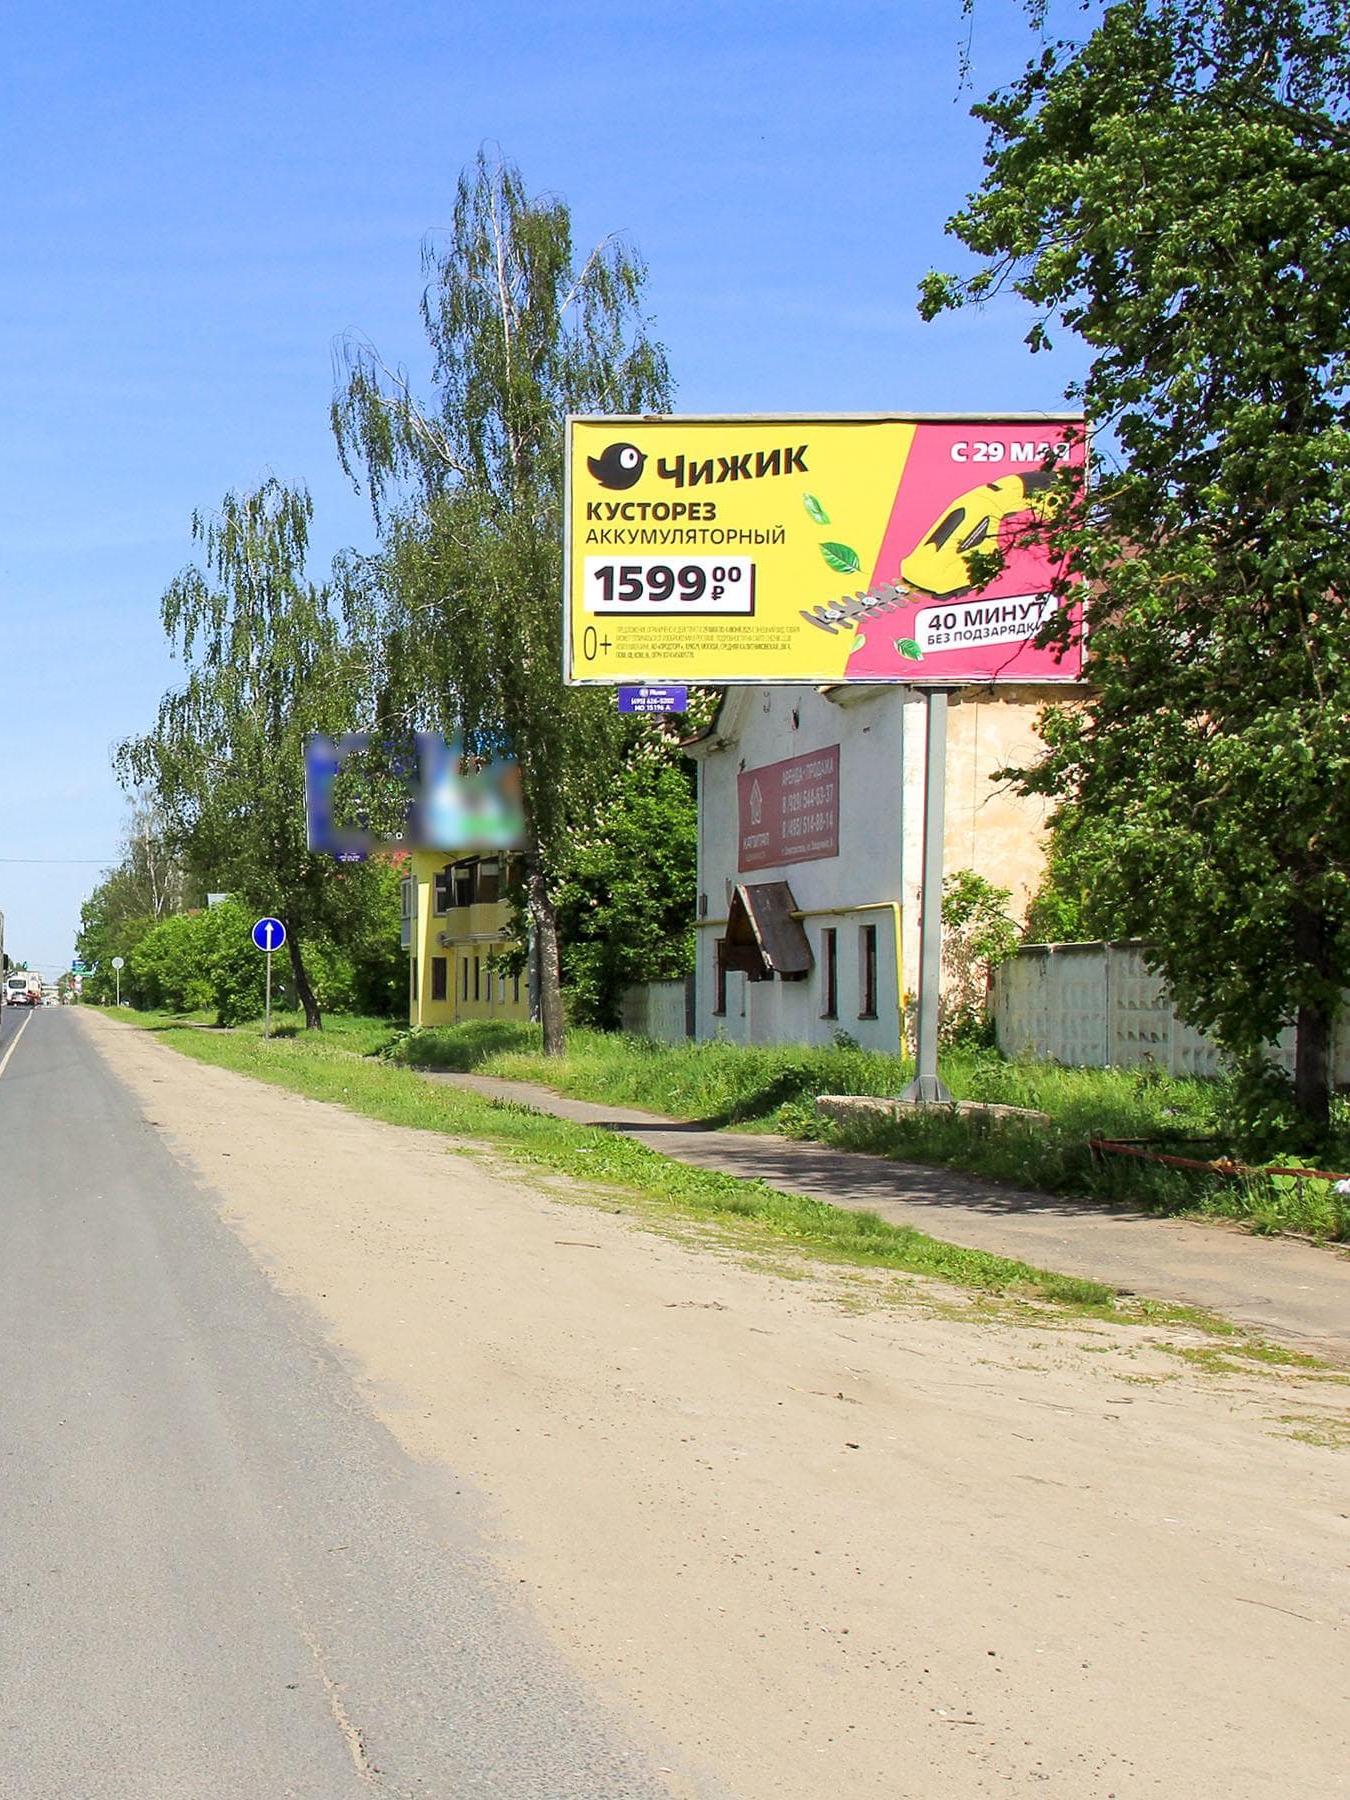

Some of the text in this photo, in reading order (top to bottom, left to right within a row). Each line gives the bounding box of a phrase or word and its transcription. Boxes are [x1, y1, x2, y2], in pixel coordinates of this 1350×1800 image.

[950, 442, 968, 462] С
[972, 442, 1004, 462] 29
[586, 502, 717, 521] КУСТОРЕЗ
[585, 525, 786, 545] АККУМУЛЯТОРНЫЙ
[593, 565, 707, 601] 1599
[928, 601, 1047, 631] 40 МИНУТ
[583, 626, 612, 661] 0+
[927, 633, 950, 645] БЕЗ
